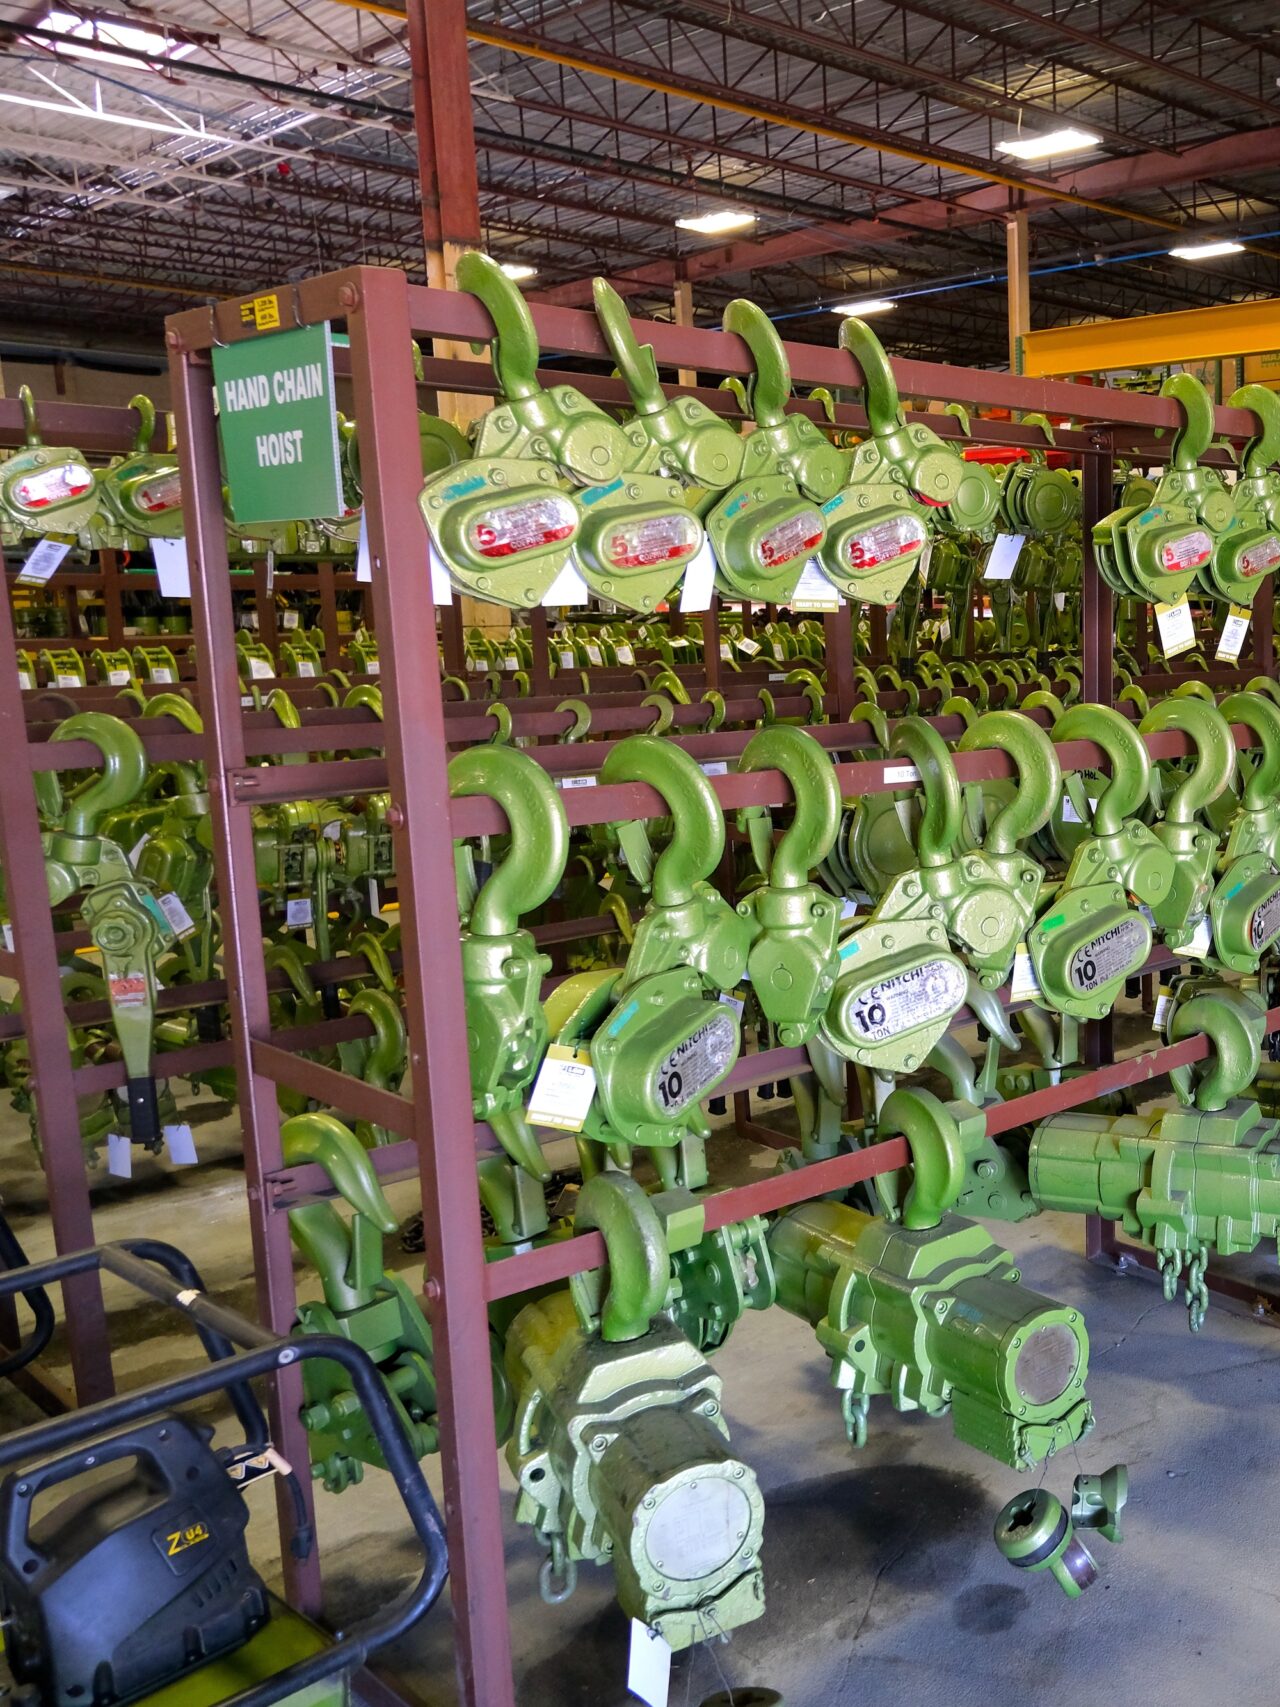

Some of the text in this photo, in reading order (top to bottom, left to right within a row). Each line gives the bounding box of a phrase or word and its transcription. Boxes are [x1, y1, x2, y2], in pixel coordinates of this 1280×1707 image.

[224, 363, 324, 412] HAND CHAIN
[256, 430, 303, 467] HOIST
[476, 524, 497, 545] 5
[611, 535, 628, 556] 5
[761, 540, 775, 560] 5
[850, 541, 865, 560] 5
[1166, 548, 1175, 561] 5
[1261, 891, 1279, 911] NITCHI
[1090, 927, 1121, 951] NITCHI
[880, 968, 923, 992] NITCHI
[1075, 960, 1096, 987] 10
[1085, 979, 1098, 991] TON
[855, 1003, 886, 1033] 10
[676, 1024, 709, 1056] NITCHI
[871, 1026, 891, 1040] TON
[658, 1071, 682, 1107] 10
